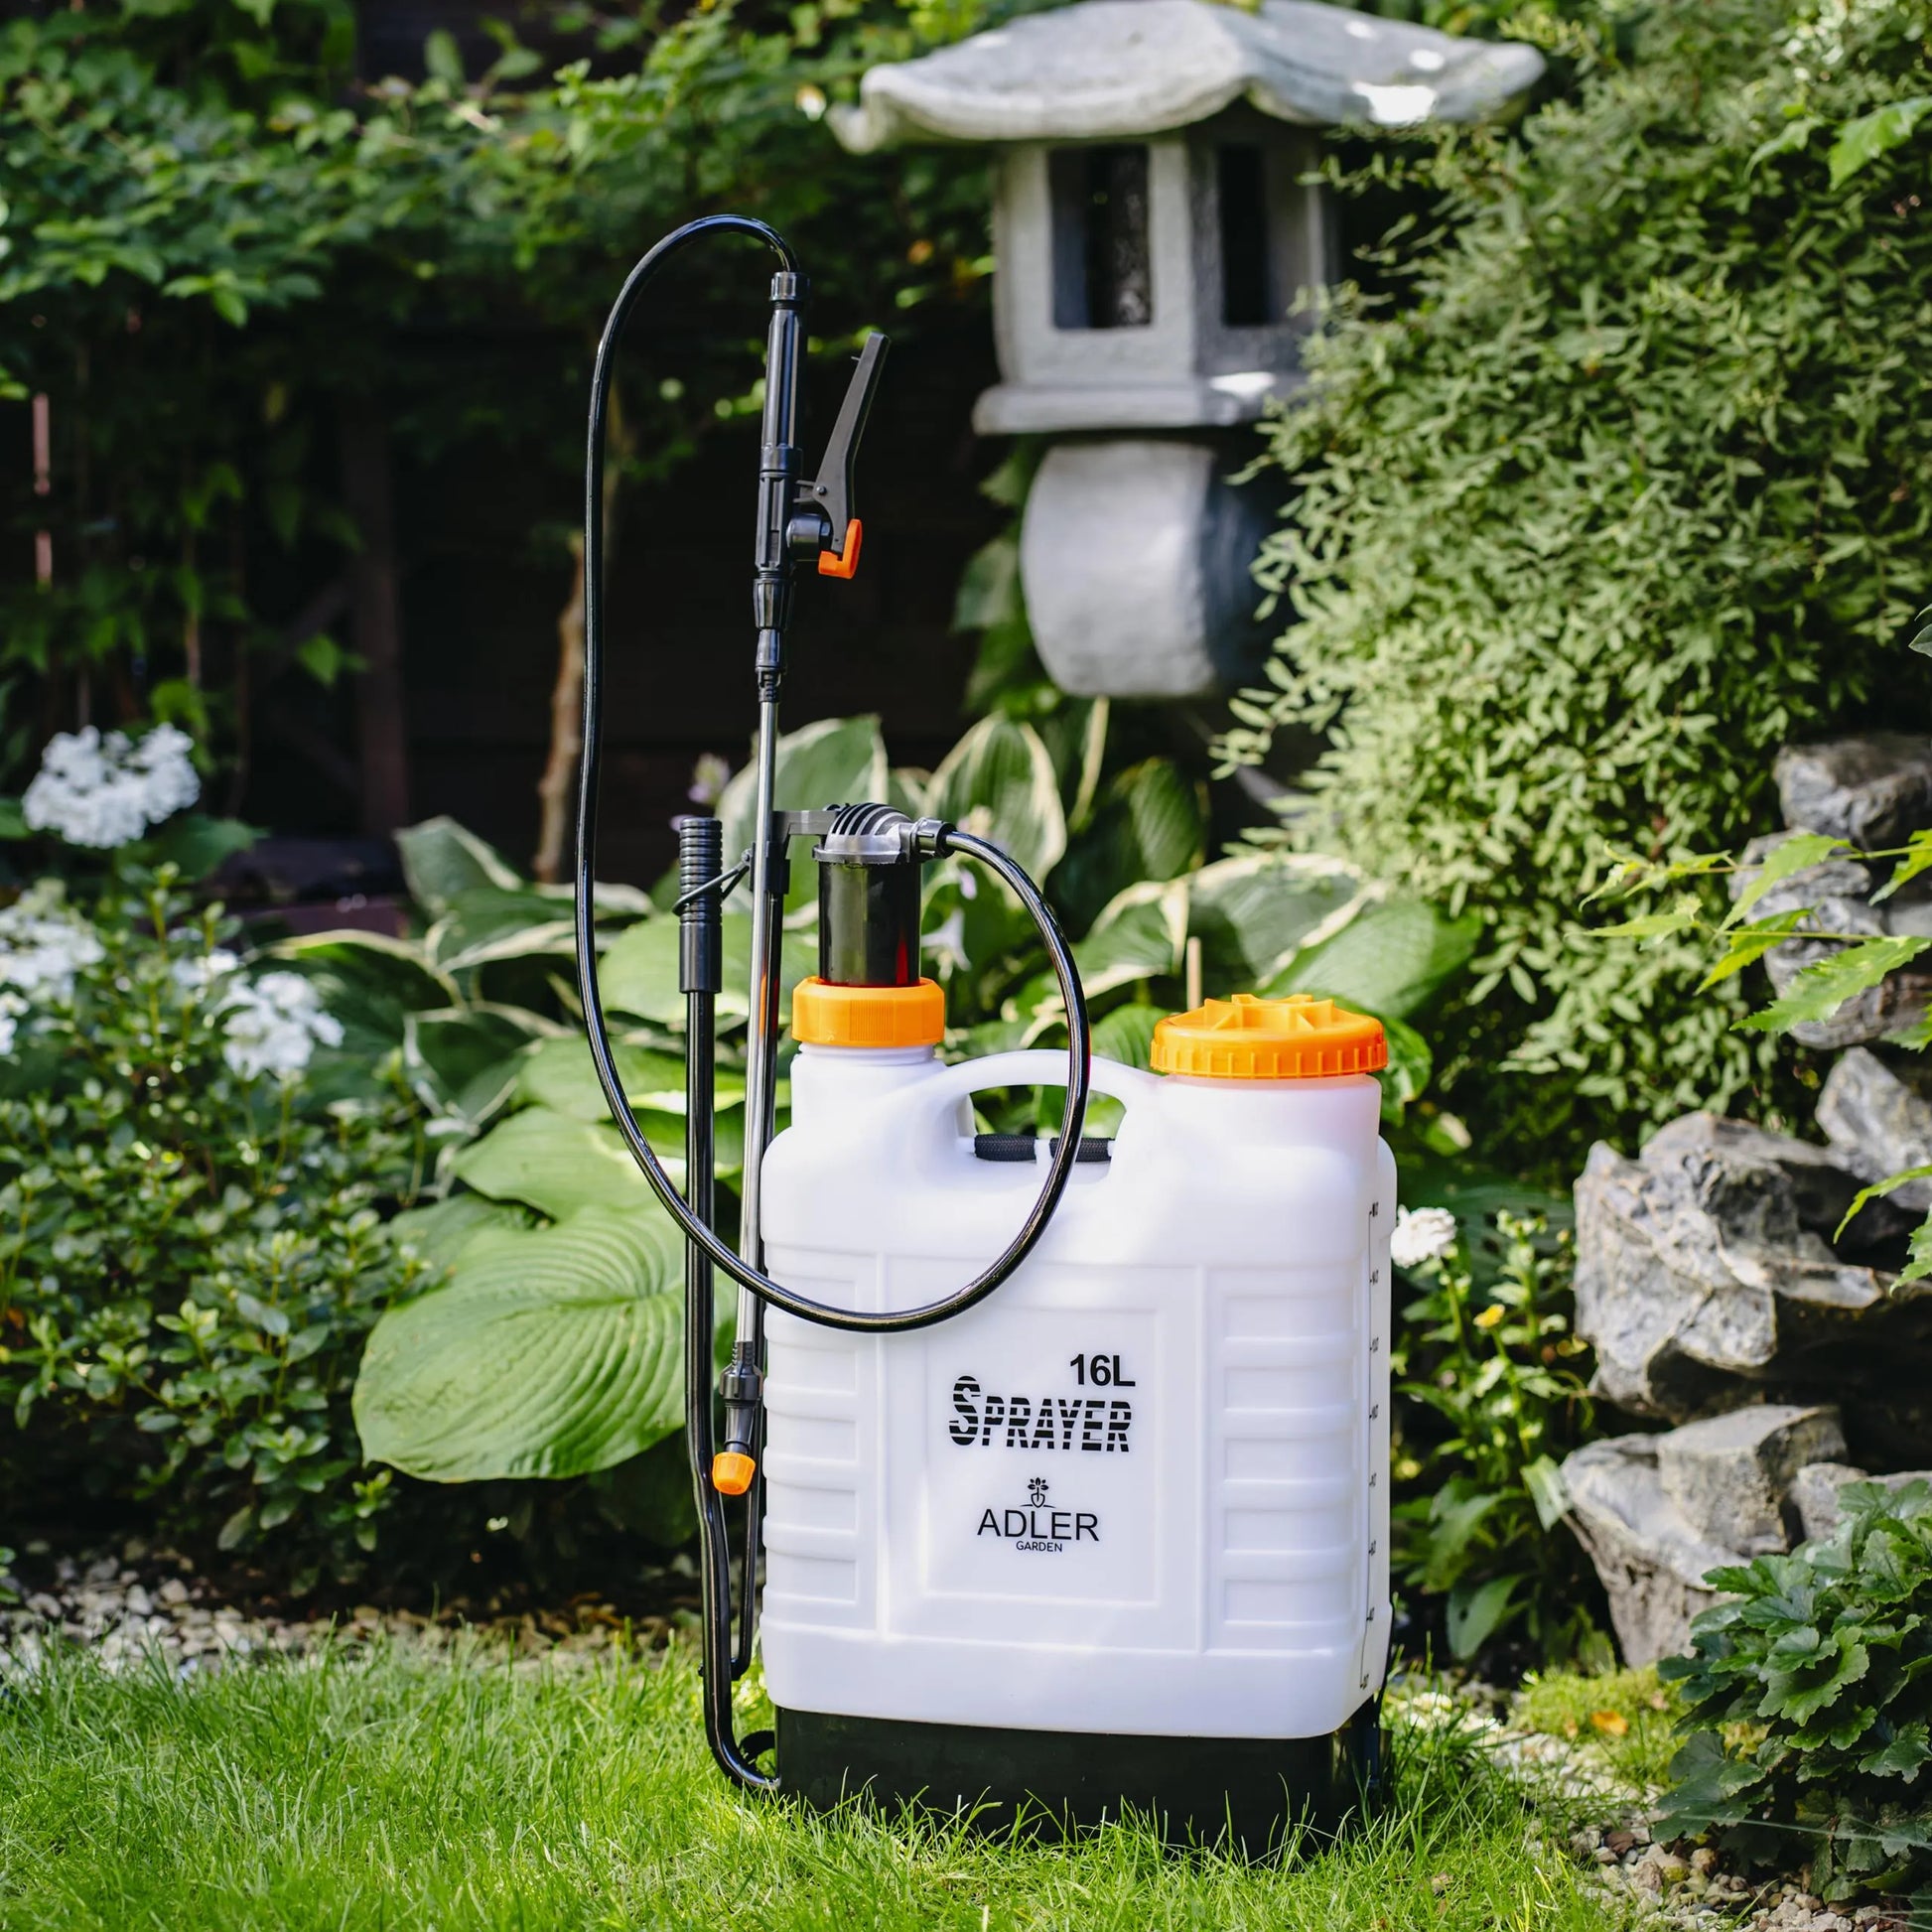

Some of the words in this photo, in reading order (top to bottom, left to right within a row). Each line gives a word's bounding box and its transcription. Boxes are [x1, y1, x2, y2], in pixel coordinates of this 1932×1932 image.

[1069, 1353, 1137, 1388] 16L
[948, 1375, 1133, 1452] SPRAYER
[976, 1508, 1100, 1542] ADLER
[1016, 1540, 1063, 1553] GARDEN
